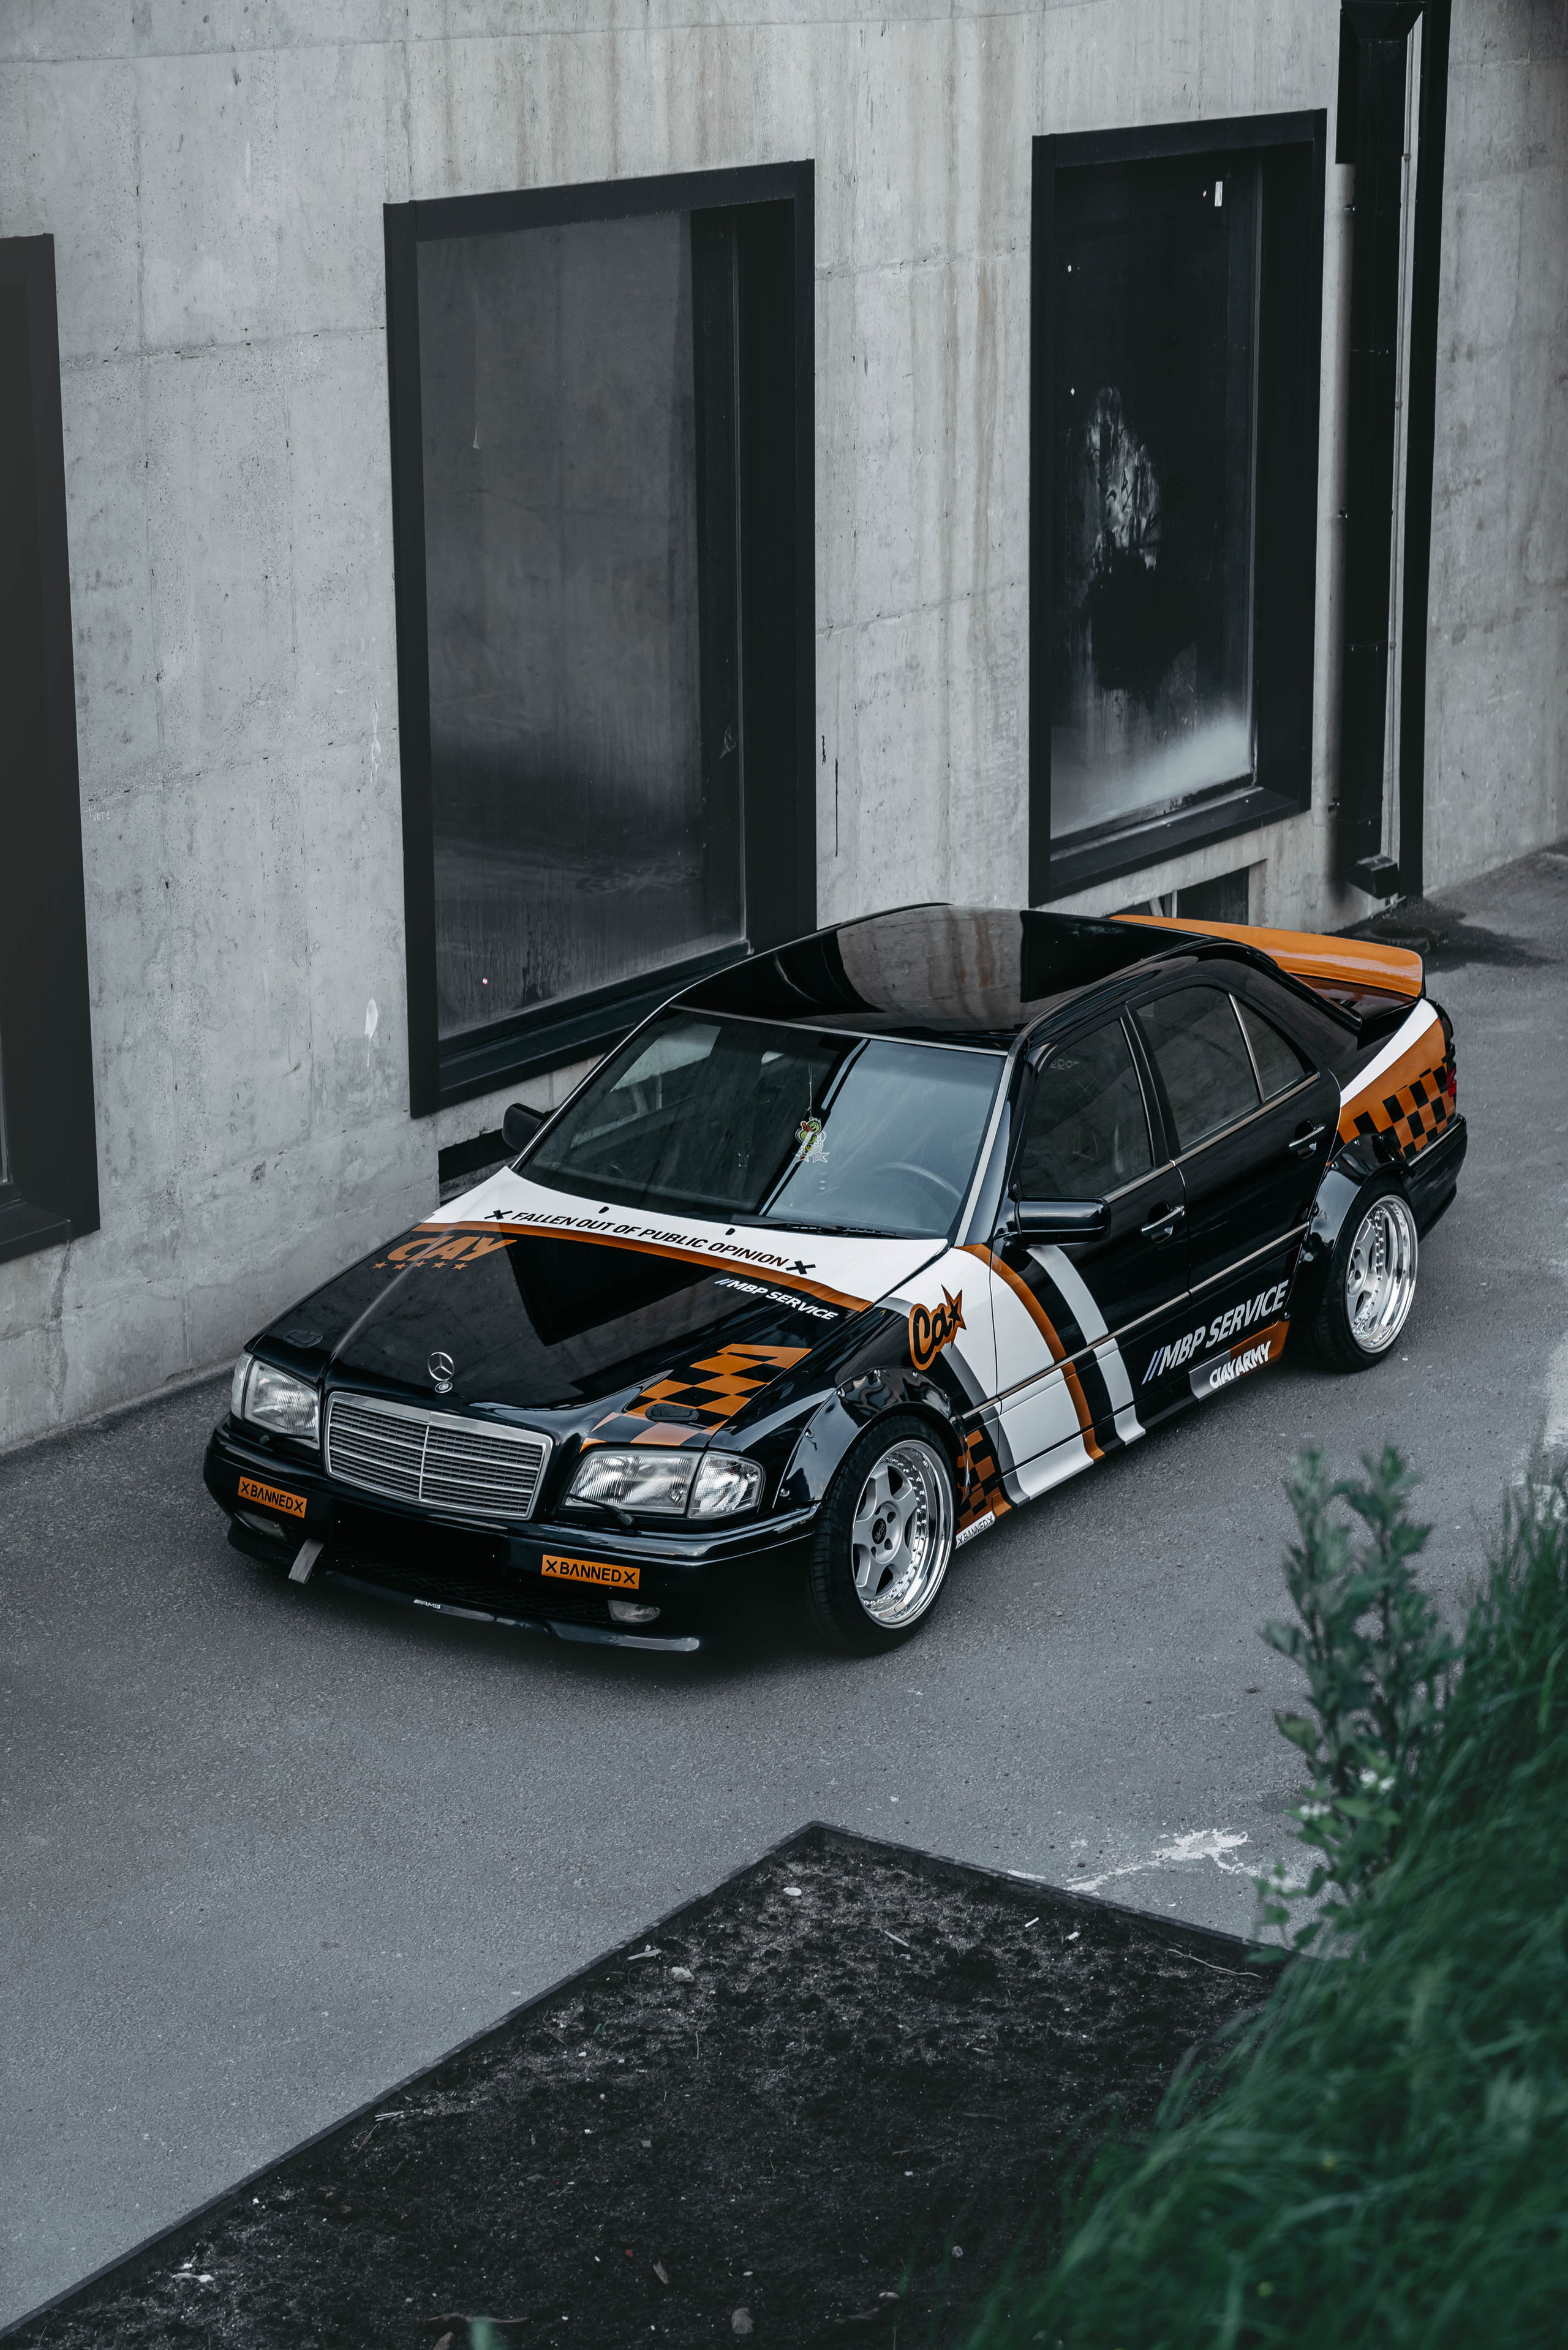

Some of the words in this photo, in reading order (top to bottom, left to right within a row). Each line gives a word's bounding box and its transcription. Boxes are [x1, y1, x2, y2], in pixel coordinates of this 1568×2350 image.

[511, 1212, 579, 1226] FALLEN
[576, 1219, 616, 1231] OUT
[612, 1224, 641, 1235] OF
[638, 1228, 709, 1248] PUBLIC
[707, 1242, 790, 1267] OPINION
[765, 1291, 839, 1320] SERVICE
[1205, 1279, 1289, 1349] SERVICE
